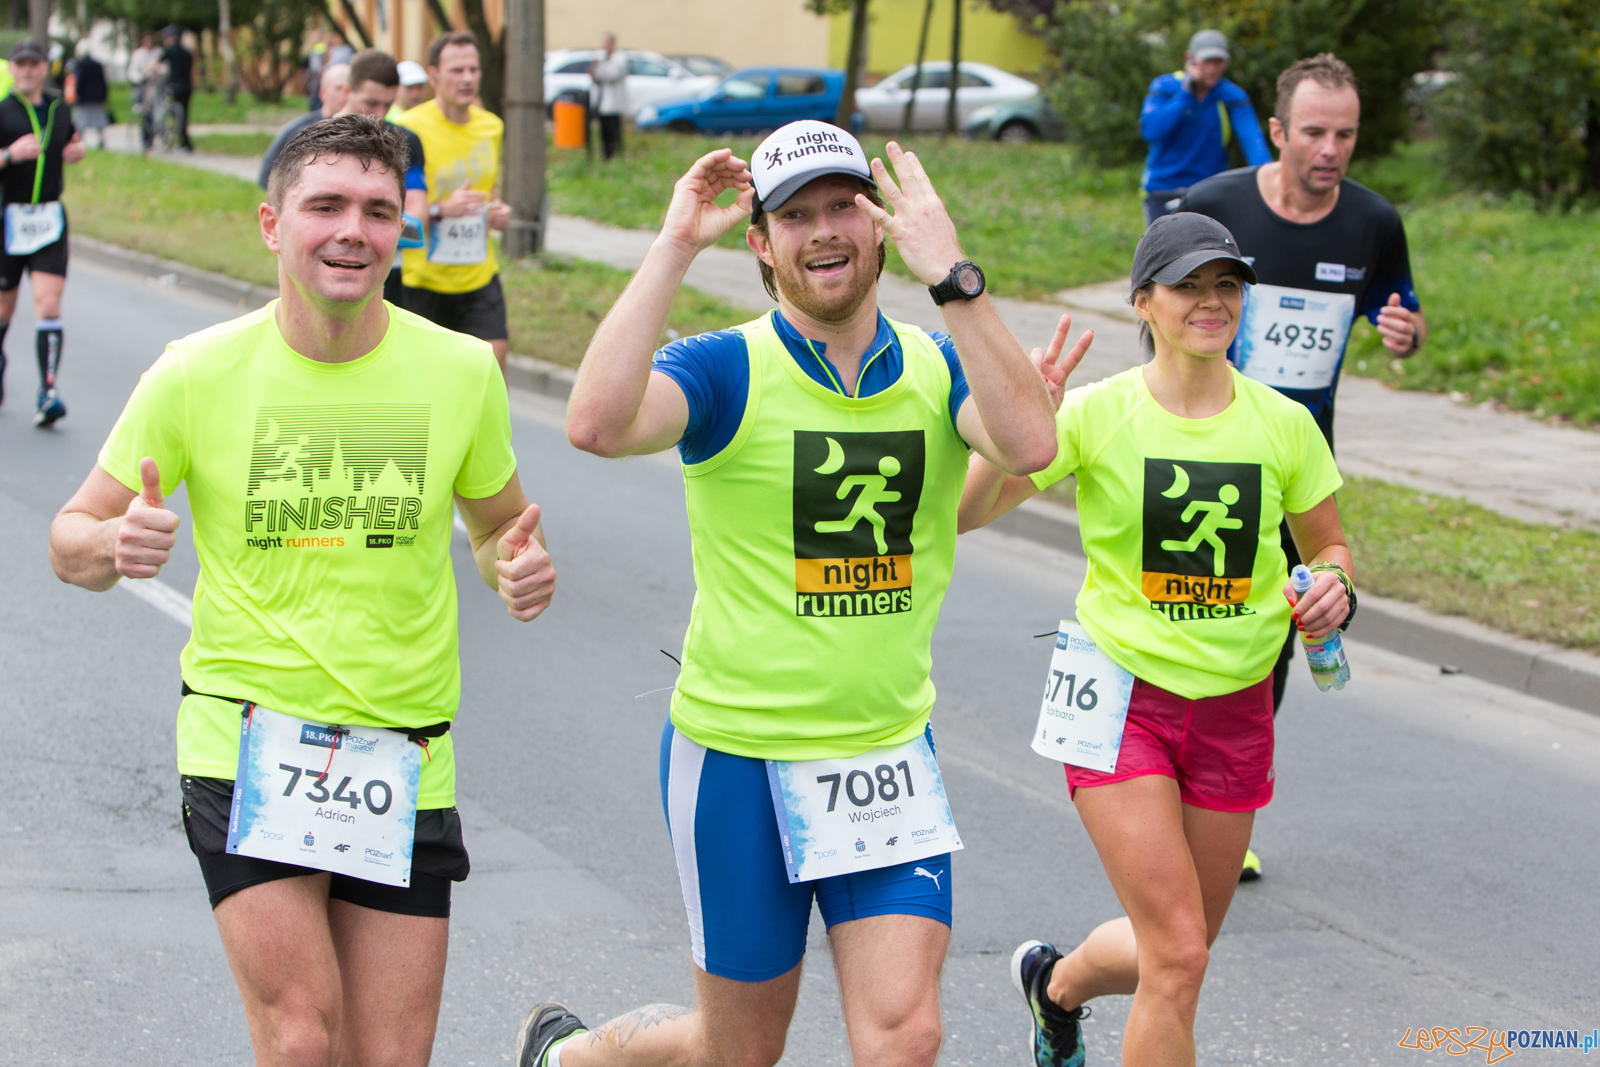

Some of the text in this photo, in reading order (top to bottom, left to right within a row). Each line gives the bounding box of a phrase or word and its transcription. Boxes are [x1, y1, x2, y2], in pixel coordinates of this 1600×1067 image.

[796, 131, 839, 145] night
[787, 143, 854, 161] runners
[1265, 322, 1334, 351] 4935
[246, 496, 422, 532] FINISHER
[247, 536, 345, 550] night runners
[824, 557, 898, 590] night
[1166, 575, 1234, 603] night
[798, 589, 912, 616] runners
[305, 730, 339, 743] 18. PKO
[345, 742, 375, 753] maraton
[279, 763, 393, 815] 7340
[816, 760, 915, 812] 7081
[315, 807, 356, 824] Adrian
[848, 805, 901, 823] Wojciech
[334, 843, 351, 853] 4F
[886, 836, 898, 847] 4F
